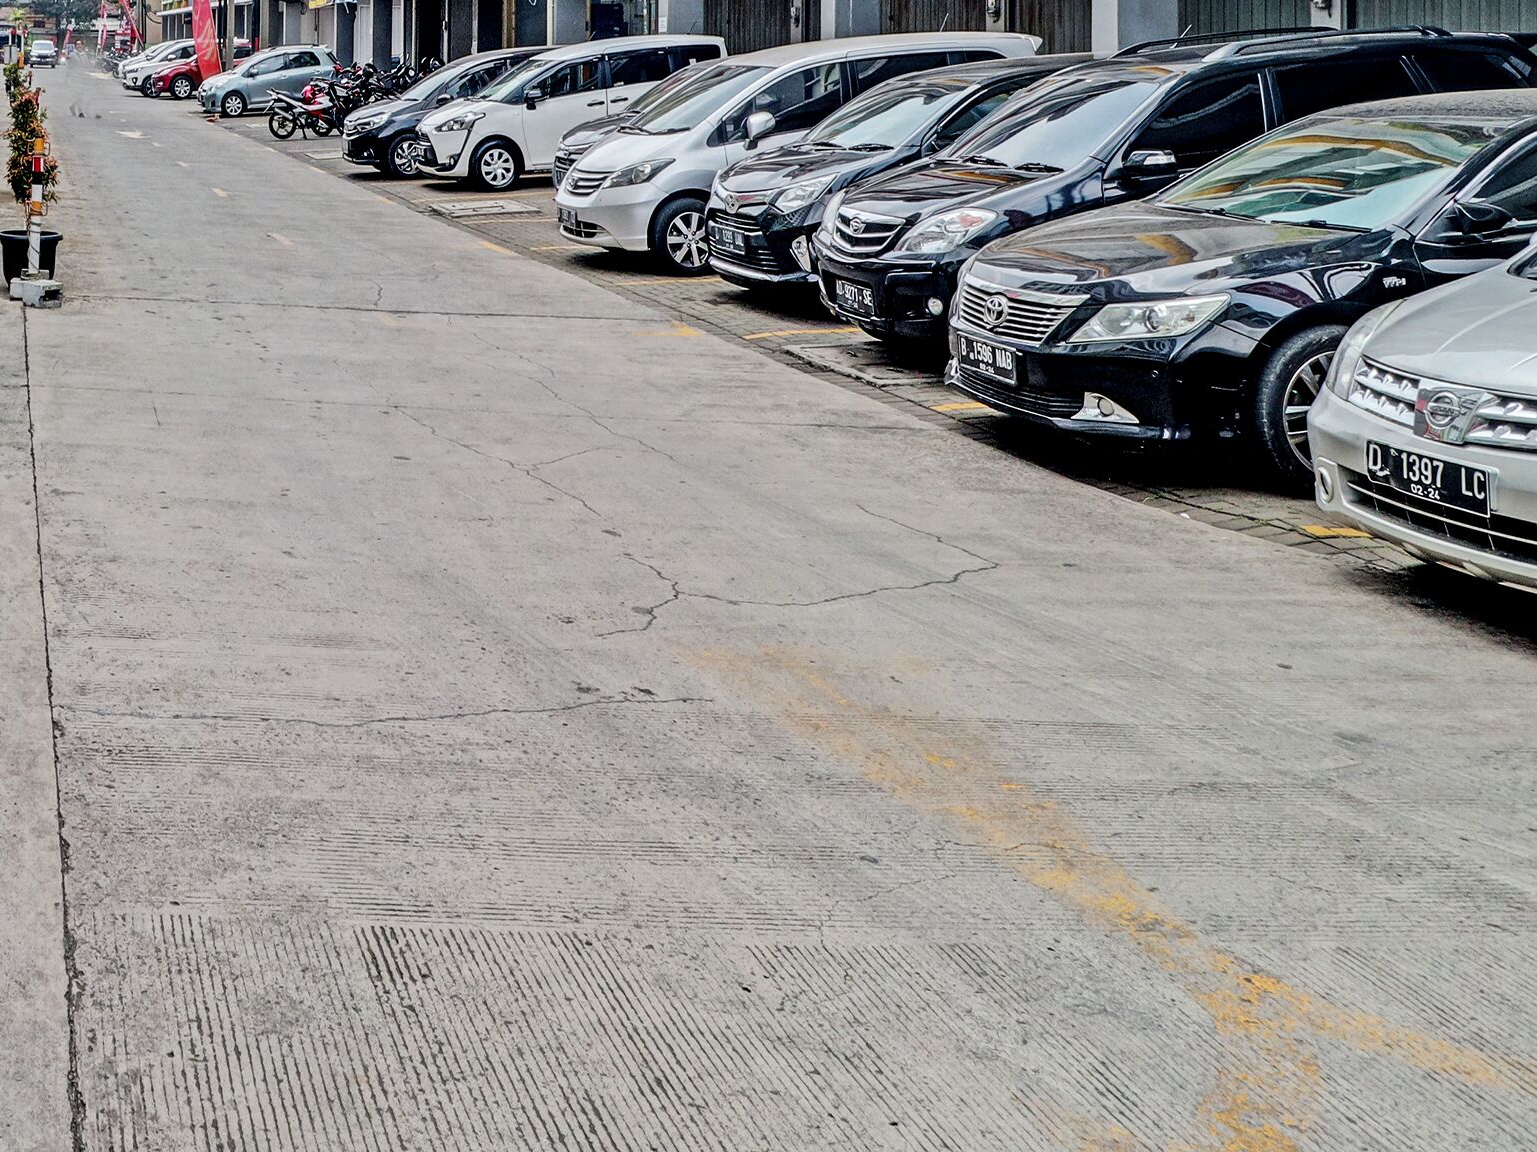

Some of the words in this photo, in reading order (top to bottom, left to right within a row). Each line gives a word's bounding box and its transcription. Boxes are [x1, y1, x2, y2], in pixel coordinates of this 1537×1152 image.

[960, 337, 967, 356] B
[972, 341, 993, 364] 1596
[995, 348, 1013, 370] NAB
[1368, 444, 1382, 471] D
[1400, 452, 1444, 488] 1397
[1461, 467, 1486, 500] LC
[1410, 483, 1441, 501] 02-24
